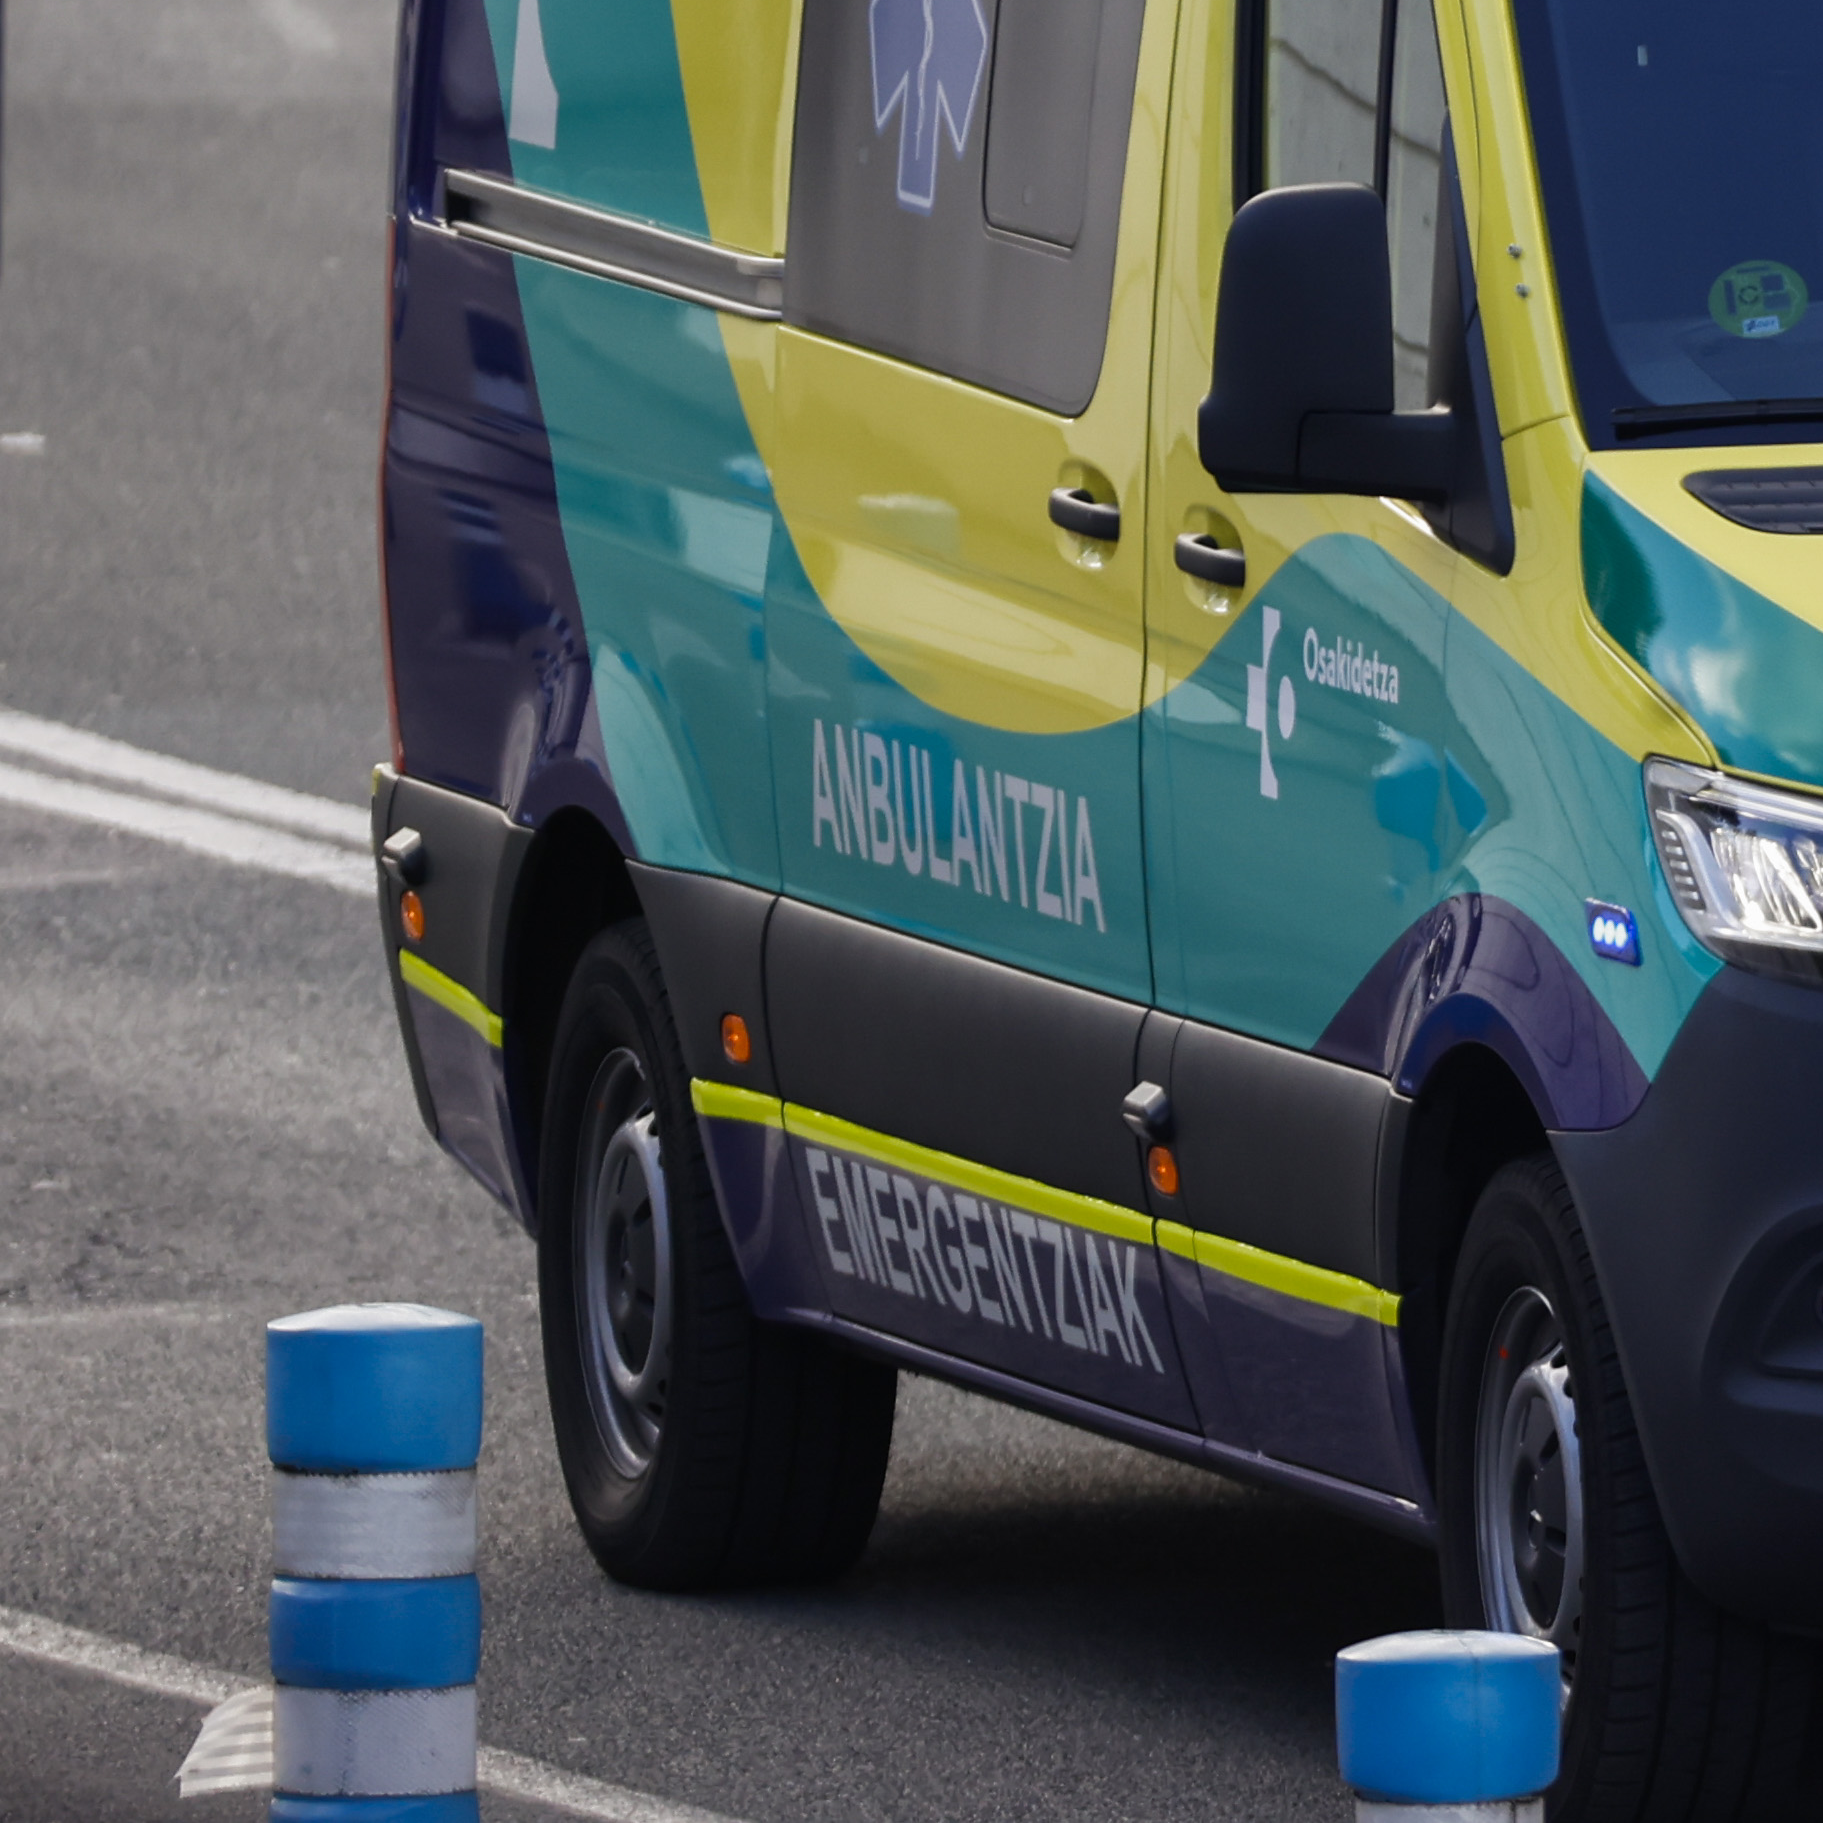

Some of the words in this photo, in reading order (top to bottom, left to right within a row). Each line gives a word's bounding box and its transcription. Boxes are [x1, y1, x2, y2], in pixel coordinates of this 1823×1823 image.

[1303, 626, 1398, 704] Osakidetza
[812, 718, 1107, 934] ANBULANTZIA
[805, 1147, 1165, 1375] EMERGENTZIAK
